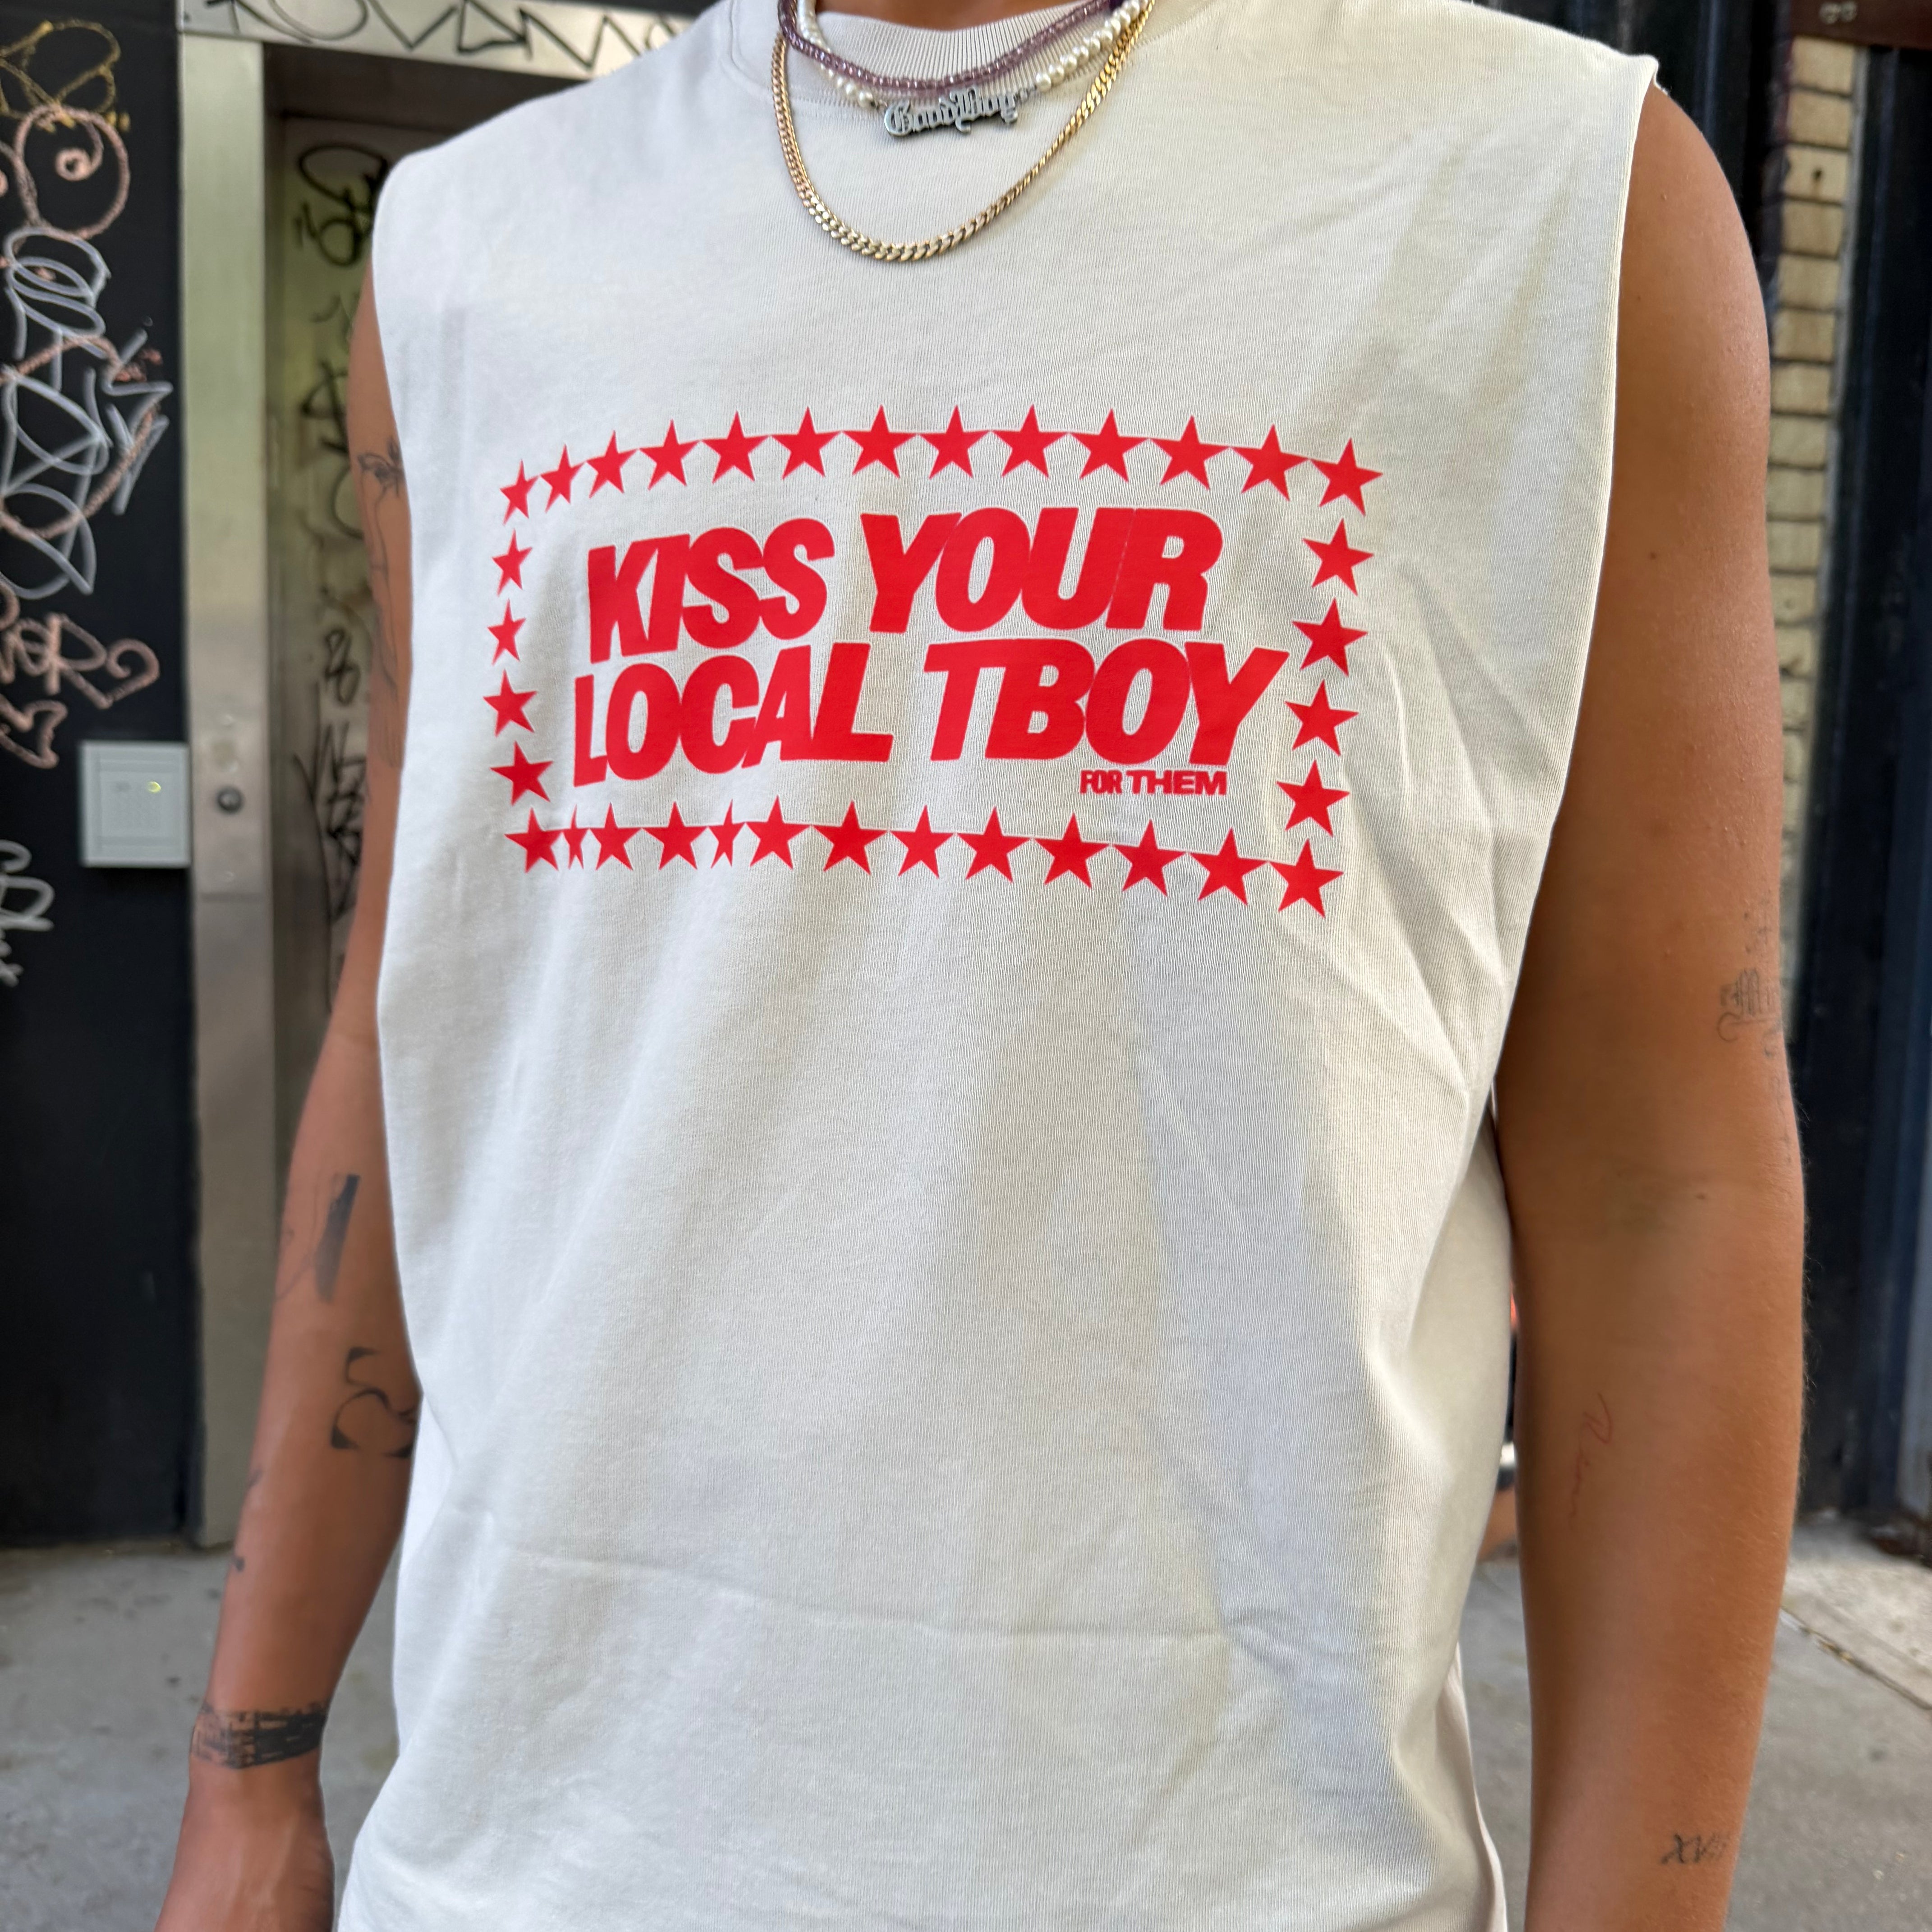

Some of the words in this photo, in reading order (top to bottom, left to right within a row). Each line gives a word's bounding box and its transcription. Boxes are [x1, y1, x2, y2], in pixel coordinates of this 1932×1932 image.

[588, 518, 835, 664] KISS
[860, 507, 1223, 634] YOUR
[573, 643, 893, 787] LOCAL
[924, 639, 1289, 766] TBOY
[1080, 769, 1122, 795] FOR
[1126, 769, 1227, 796] THEM
